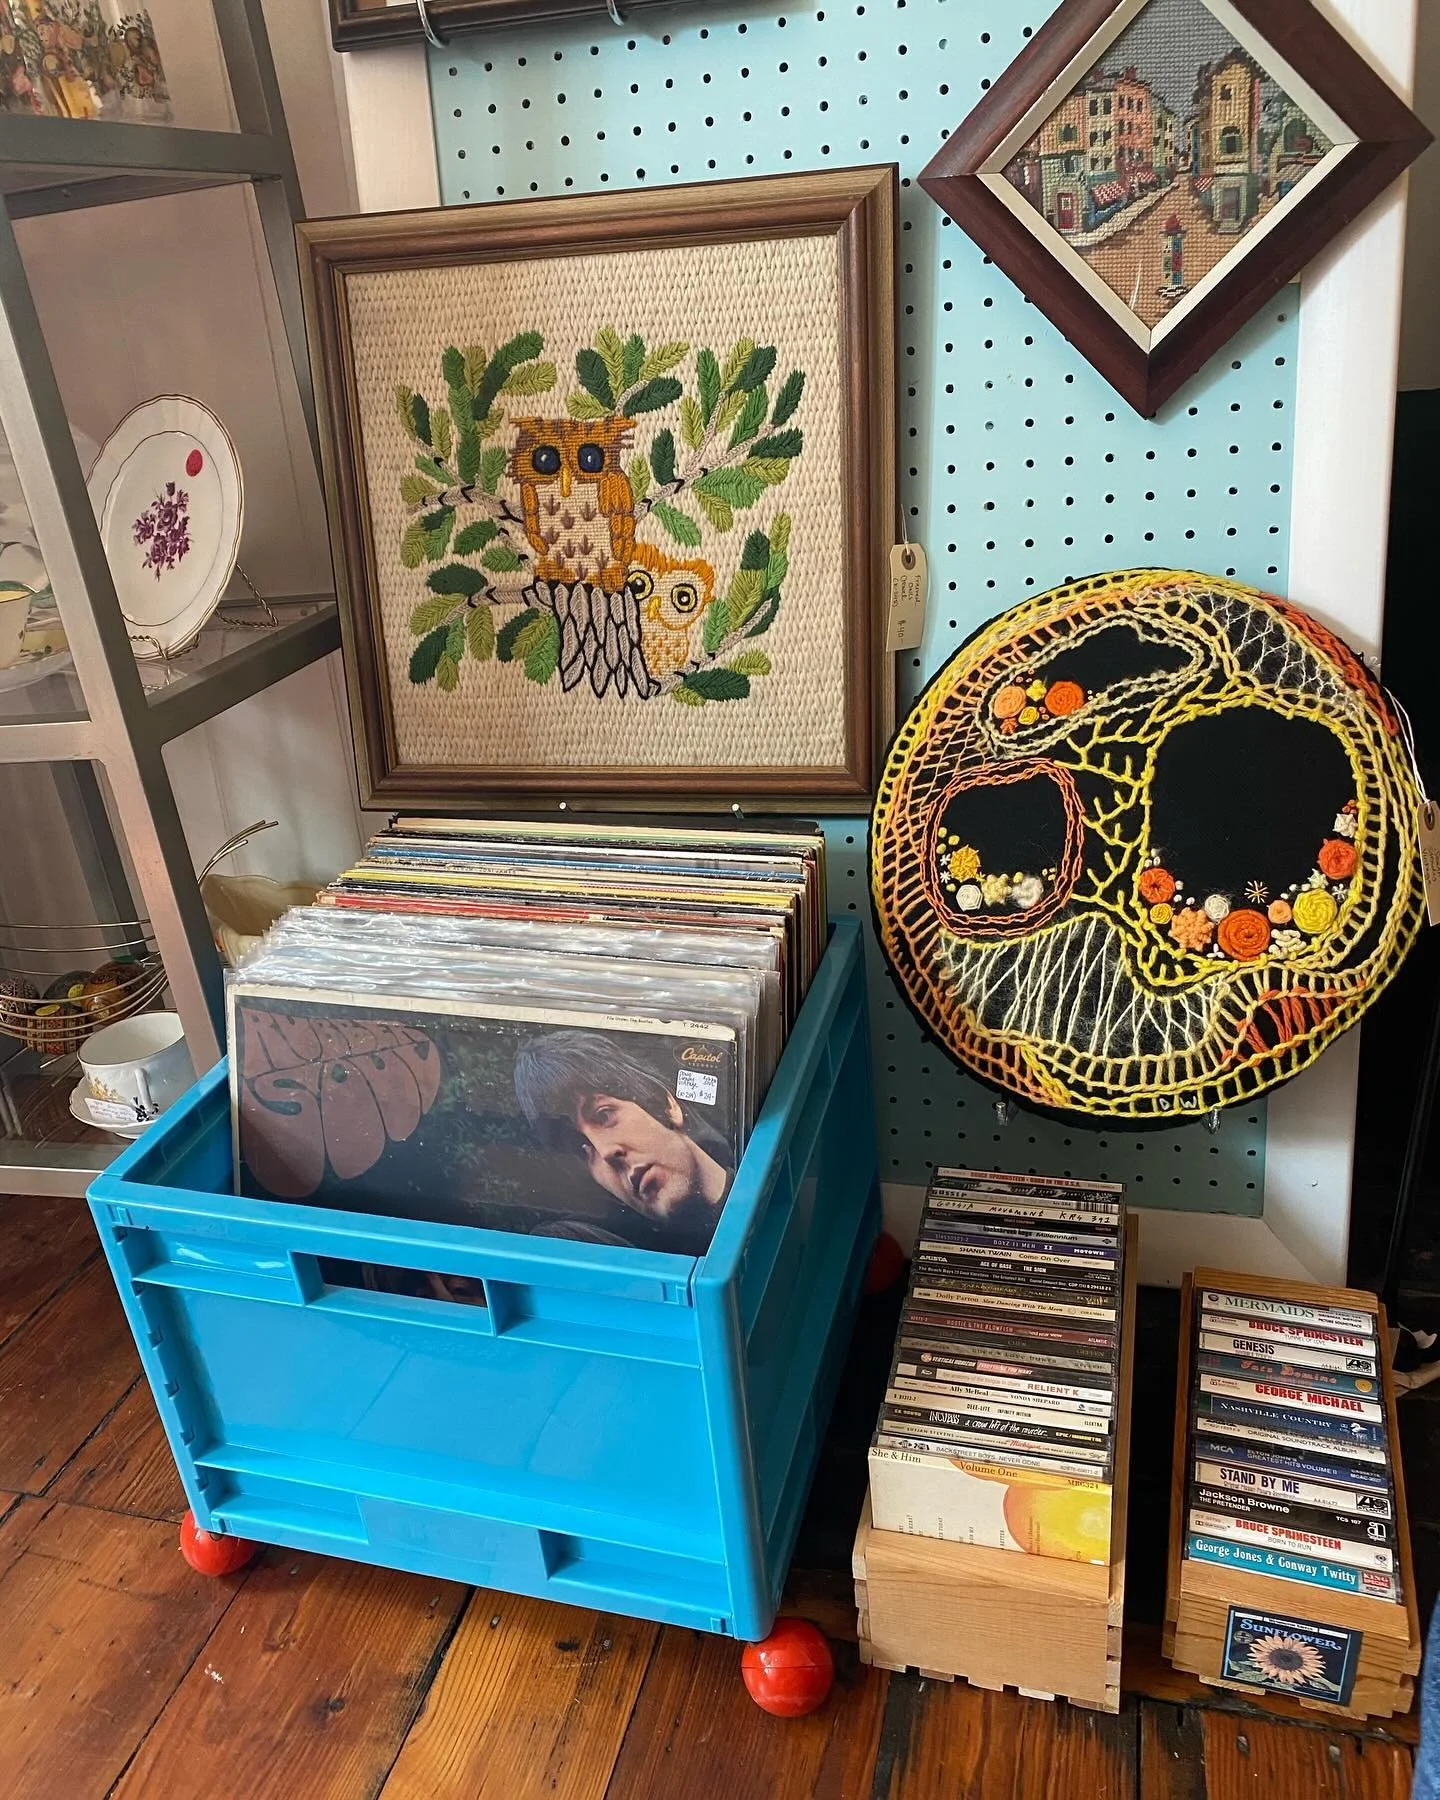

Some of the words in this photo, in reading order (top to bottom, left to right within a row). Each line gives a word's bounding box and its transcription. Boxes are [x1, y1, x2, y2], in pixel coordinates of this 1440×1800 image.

[681, 1047, 723, 1063] Capitol
[989, 1173, 1026, 1182] SPRINGSTEEN
[932, 1189, 968, 1198] GOSSIP
[1036, 1232, 1078, 1241] Millennium
[919, 1254, 948, 1263] ARISTA
[959, 1246, 986, 1255] SHANIA
[988, 1249, 1012, 1257] TWAIN
[1073, 1248, 1105, 1256] MOTOWN
[999, 1262, 1012, 1270] BASE
[935, 1292, 954, 1301] Dolly
[956, 1294, 979, 1303] Parton
[996, 1299, 1022, 1309] Dancing
[1225, 1296, 1315, 1319] MERMAIDS
[1334, 1319, 1362, 1328] SOUNDTRACK
[946, 1319, 967, 1327] HOOTIE
[984, 1324, 1014, 1333] BLOWFISH
[1087, 1337, 1108, 1345] ATLANTIC
[1248, 1320, 1286, 1333] BRUCE
[1287, 1327, 1364, 1347] SPRINGSTEEN
[1232, 1339, 1275, 1355] GENESIS
[932, 1356, 954, 1364] VERTICAL
[954, 1358, 977, 1367] HORIZON
[1240, 1359, 1273, 1373] Fats
[1280, 1364, 1337, 1384] Domino
[950, 1385, 964, 1394] Ally
[965, 1387, 989, 1397] McBeal
[1032, 1397, 1060, 1406] SHEPARD
[1027, 1383, 1070, 1395] RELIENT
[1072, 1388, 1080, 1396] K
[1255, 1383, 1304, 1401] GEORGE
[1307, 1394, 1365, 1413] MICHAEL
[929, 1410, 960, 1424] INCUBUS
[1000, 1421, 1009, 1431] of
[1009, 1422, 1019, 1433] the
[1220, 1402, 1279, 1418] NASHVILLE
[1282, 1413, 1333, 1428] COUNTRY
[1084, 1420, 1103, 1428] ELEKTRA
[929, 1429, 955, 1438] STEVENS
[1247, 1429, 1280, 1440] ORIGINAL
[1281, 1435, 1330, 1449] SOUNDTRACK
[1333, 1445, 1358, 1454] ALBUM
[935, 1446, 977, 1457] BACKSTREET
[998, 1455, 1021, 1464] NEVER
[1021, 1457, 1041, 1467] GONE
[1210, 1443, 1234, 1454] MCA
[1247, 1449, 1270, 1457] ELTON
[1271, 1452, 1297, 1462] JOHN'S
[871, 1448, 889, 1458] She
[890, 1451, 898, 1459] &
[901, 1453, 921, 1463] Him
[960, 1461, 996, 1476] Volume
[997, 1467, 1018, 1478] One
[1247, 1453, 1283, 1465] GREATEST
[1284, 1460, 1301, 1468] HITS
[1301, 1463, 1333, 1474] VOLUME
[1220, 1467, 1256, 1485] STAND
[1261, 1475, 1277, 1489] BY
[1282, 1479, 1300, 1494] ME
[1199, 1488, 1245, 1504] Jackson
[1247, 1498, 1290, 1514] Browne
[1199, 1495, 1212, 1503] THE
[1212, 1498, 1251, 1512] PRETENDER
[1336, 1515, 1349, 1523] TCS
[1235, 1519, 1269, 1535] BRUCE
[1271, 1527, 1342, 1550] SPRINGSTEEN
[1267, 1536, 1287, 1545] BORN
[1287, 1540, 1297, 1548] TO
[1297, 1543, 1312, 1551] RUN
[1195, 1539, 1230, 1557] George
[1233, 1547, 1263, 1563] Jones
[1265, 1553, 1275, 1566] &
[1278, 1556, 1318, 1577] Conway
[1320, 1564, 1357, 1585] Twitty
[1363, 1572, 1389, 1583] KING
[1240, 1618, 1342, 1650] SUNFLOWER
